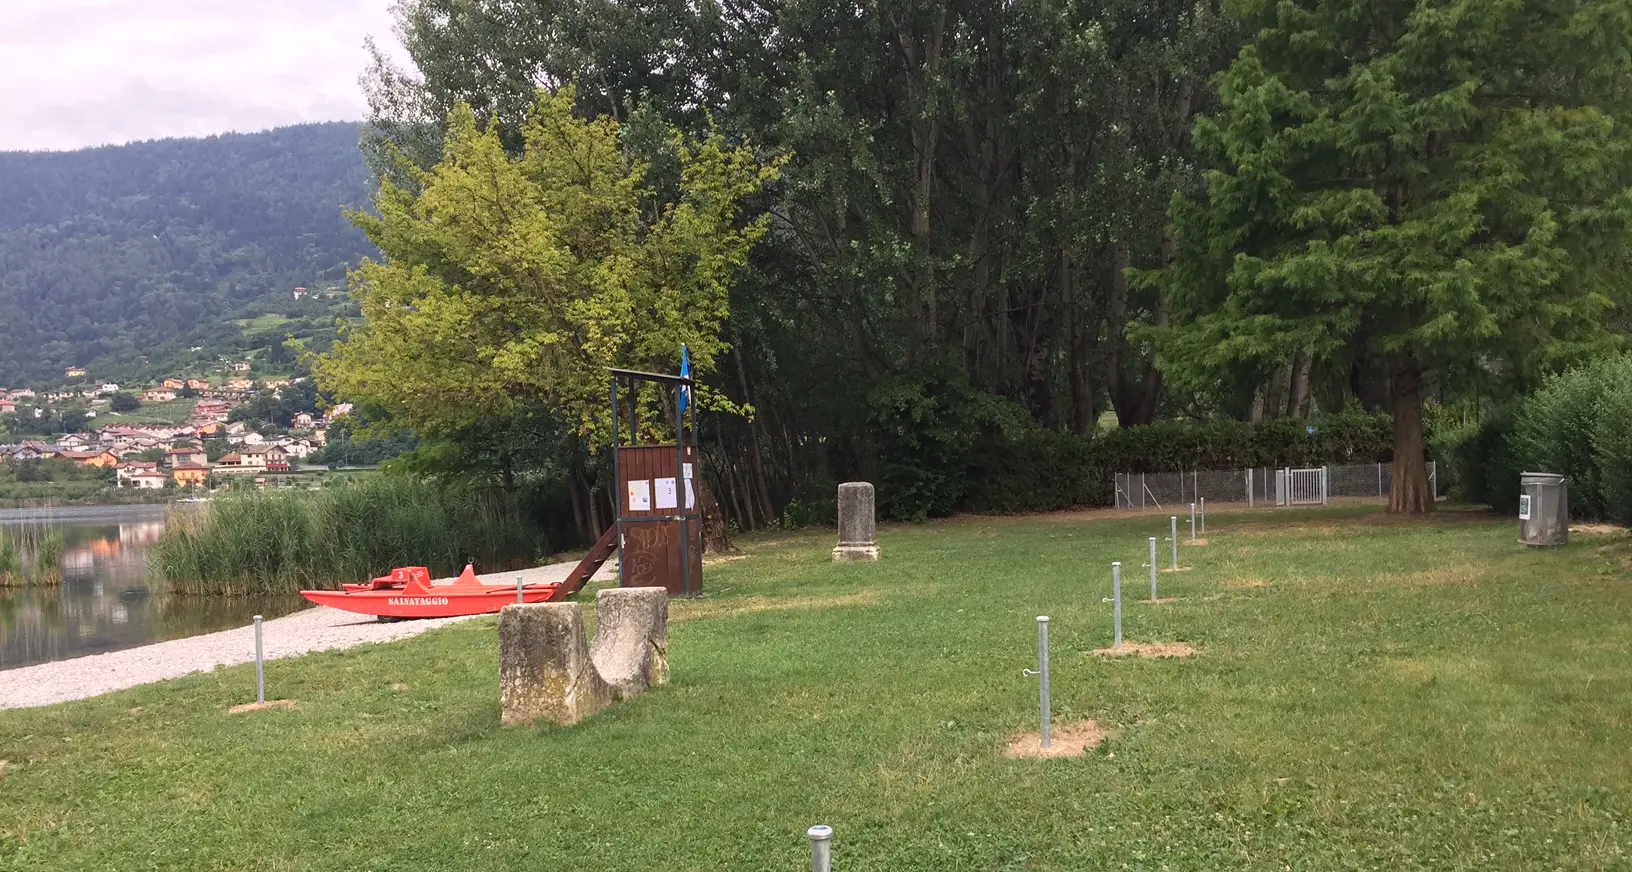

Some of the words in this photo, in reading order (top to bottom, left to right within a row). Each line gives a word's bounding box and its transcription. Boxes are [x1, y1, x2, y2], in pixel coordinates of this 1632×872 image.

[668, 487, 672, 495] 3
[398, 571, 404, 579] 3
[388, 597, 449, 606] SALVATAGGIO
